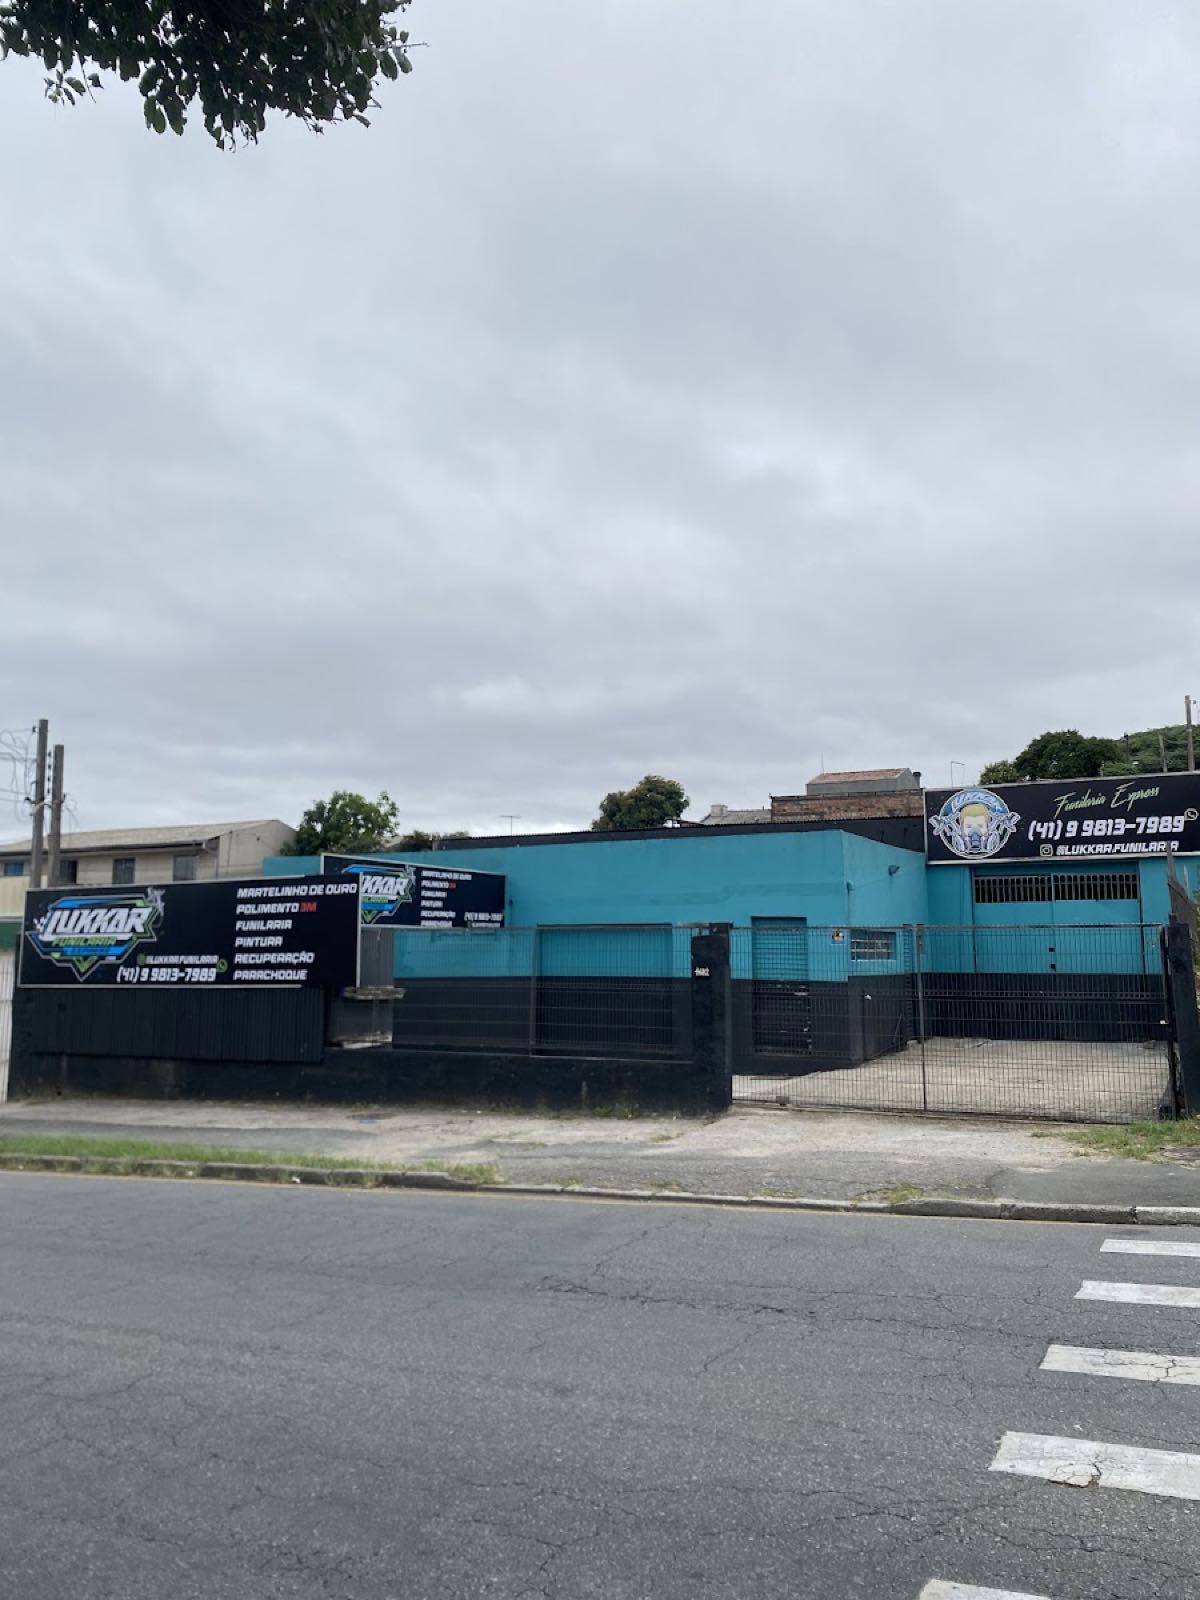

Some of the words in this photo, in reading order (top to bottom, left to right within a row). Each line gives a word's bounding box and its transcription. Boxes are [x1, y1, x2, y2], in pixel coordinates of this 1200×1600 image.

[1110, 781, 1160, 812] Express
[1028, 820, 1063, 841] (41)
[1065, 820, 1078, 837] 9
[1081, 815, 1185, 837] 9813-7989
[1056, 841, 1179, 856] @LUKKAR.FUNILARA
[236, 886, 308, 898] MARTELINHO
[308, 885, 325, 895] DE
[325, 883, 358, 894] OURO
[360, 875, 409, 896] KKAR
[236, 903, 299, 915] POLIMENTO
[40, 907, 152, 940] LUKKAR
[235, 919, 292, 931] FUNILARIA
[234, 936, 283, 948] PINTURA
[234, 951, 315, 966] RECUPERAÇÃO
[116, 966, 140, 983] (41)
[140, 967, 149, 982] 9
[150, 967, 217, 982] 9813-7989
[233, 969, 308, 981] PARACHOQUE
